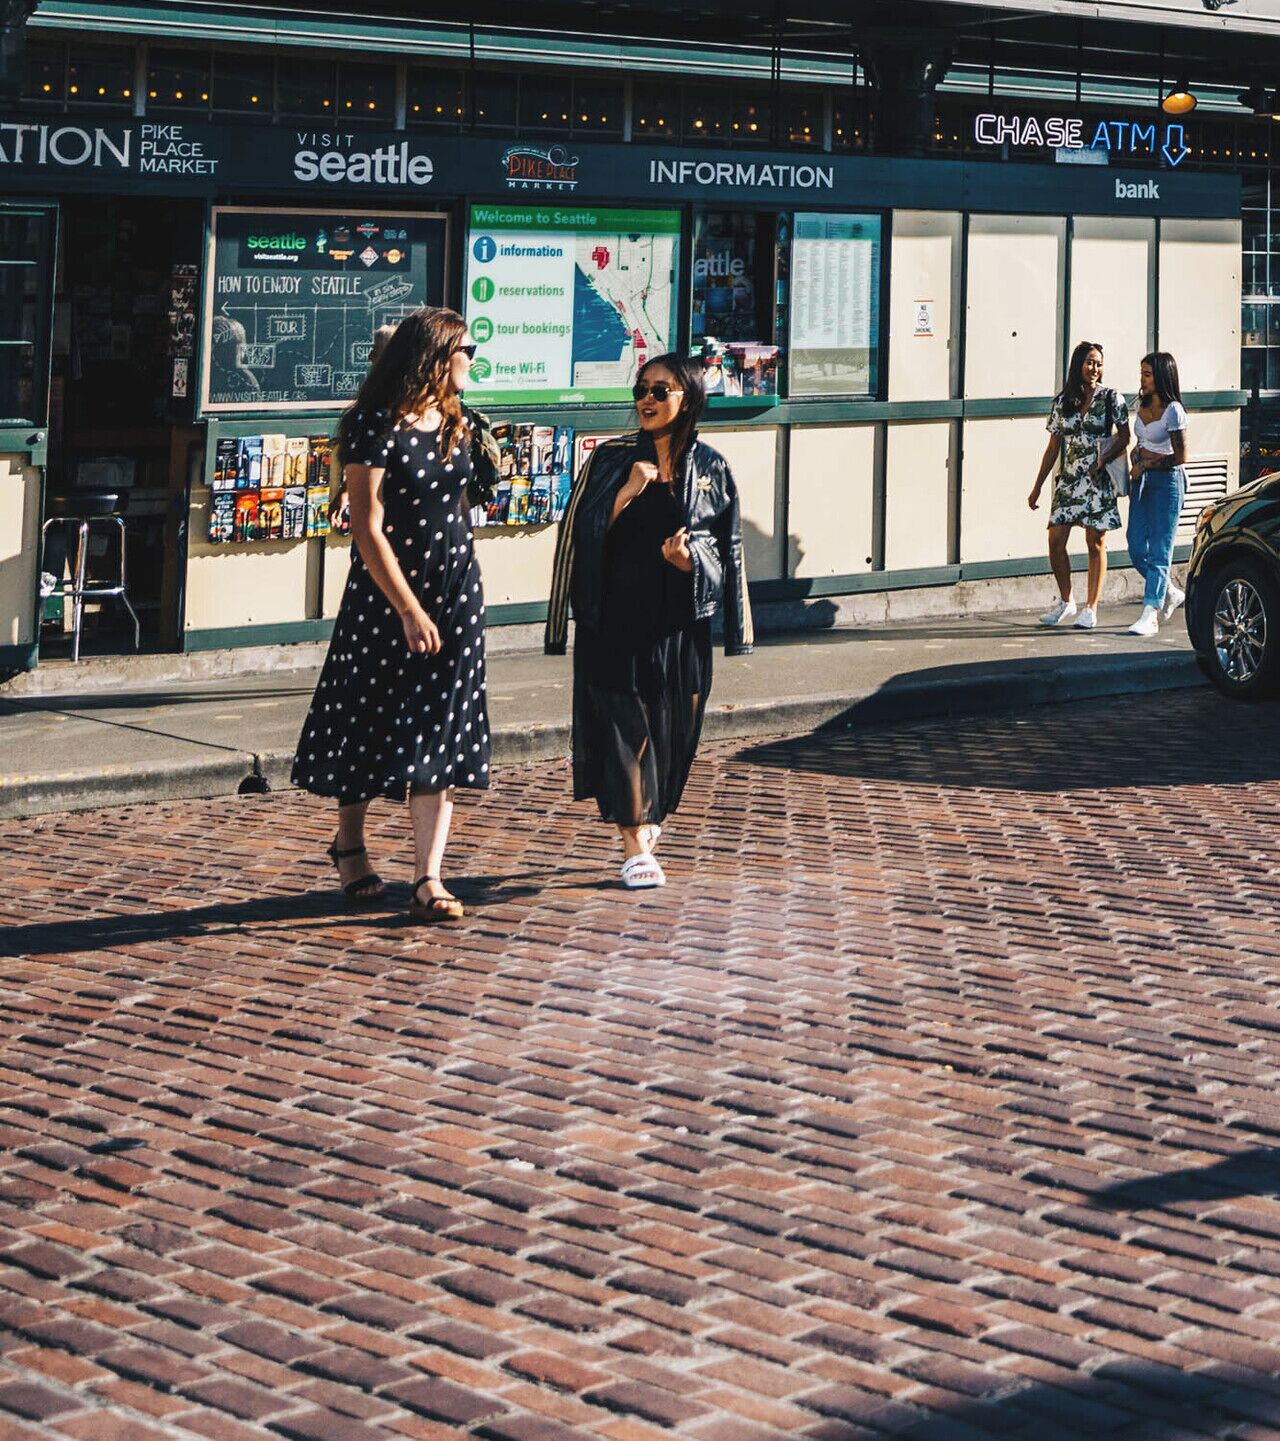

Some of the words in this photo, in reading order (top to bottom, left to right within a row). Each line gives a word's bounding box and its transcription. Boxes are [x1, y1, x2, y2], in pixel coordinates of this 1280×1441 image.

[297, 133, 355, 147] VISIT
[975, 114, 1084, 148] CHASE
[1091, 121, 1155, 152] ATM
[0, 123, 132, 167] TION
[141, 125, 183, 140] PIKE
[140, 141, 204, 157] PLACE
[140, 159, 218, 173] MARKET
[293, 141, 433, 185] seattle
[508, 155, 543, 178] PIKE
[546, 163, 577, 180] PLACE
[650, 160, 834, 188] INFORMATION
[508, 181, 575, 191] MARKET
[1116, 179, 1160, 199] bank
[474, 211, 532, 224] Welcome
[537, 213, 550, 224] to
[553, 213, 598, 225] Seattle
[247, 232, 306, 250] seattle
[254, 253, 298, 262] visitseattle.org
[500, 245, 563, 257] information
[218, 276, 242, 293] HOW
[245, 276, 260, 293] TO
[262, 276, 302, 294] ENJOY
[311, 276, 362, 295] SEATTLE
[498, 285, 565, 296] reservations
[274, 320, 298, 334] TOUR
[497, 324, 519, 334] tour
[522, 322, 571, 337] bookings
[495, 363, 516, 374] free
[519, 362, 545, 374] Wi-Fi
